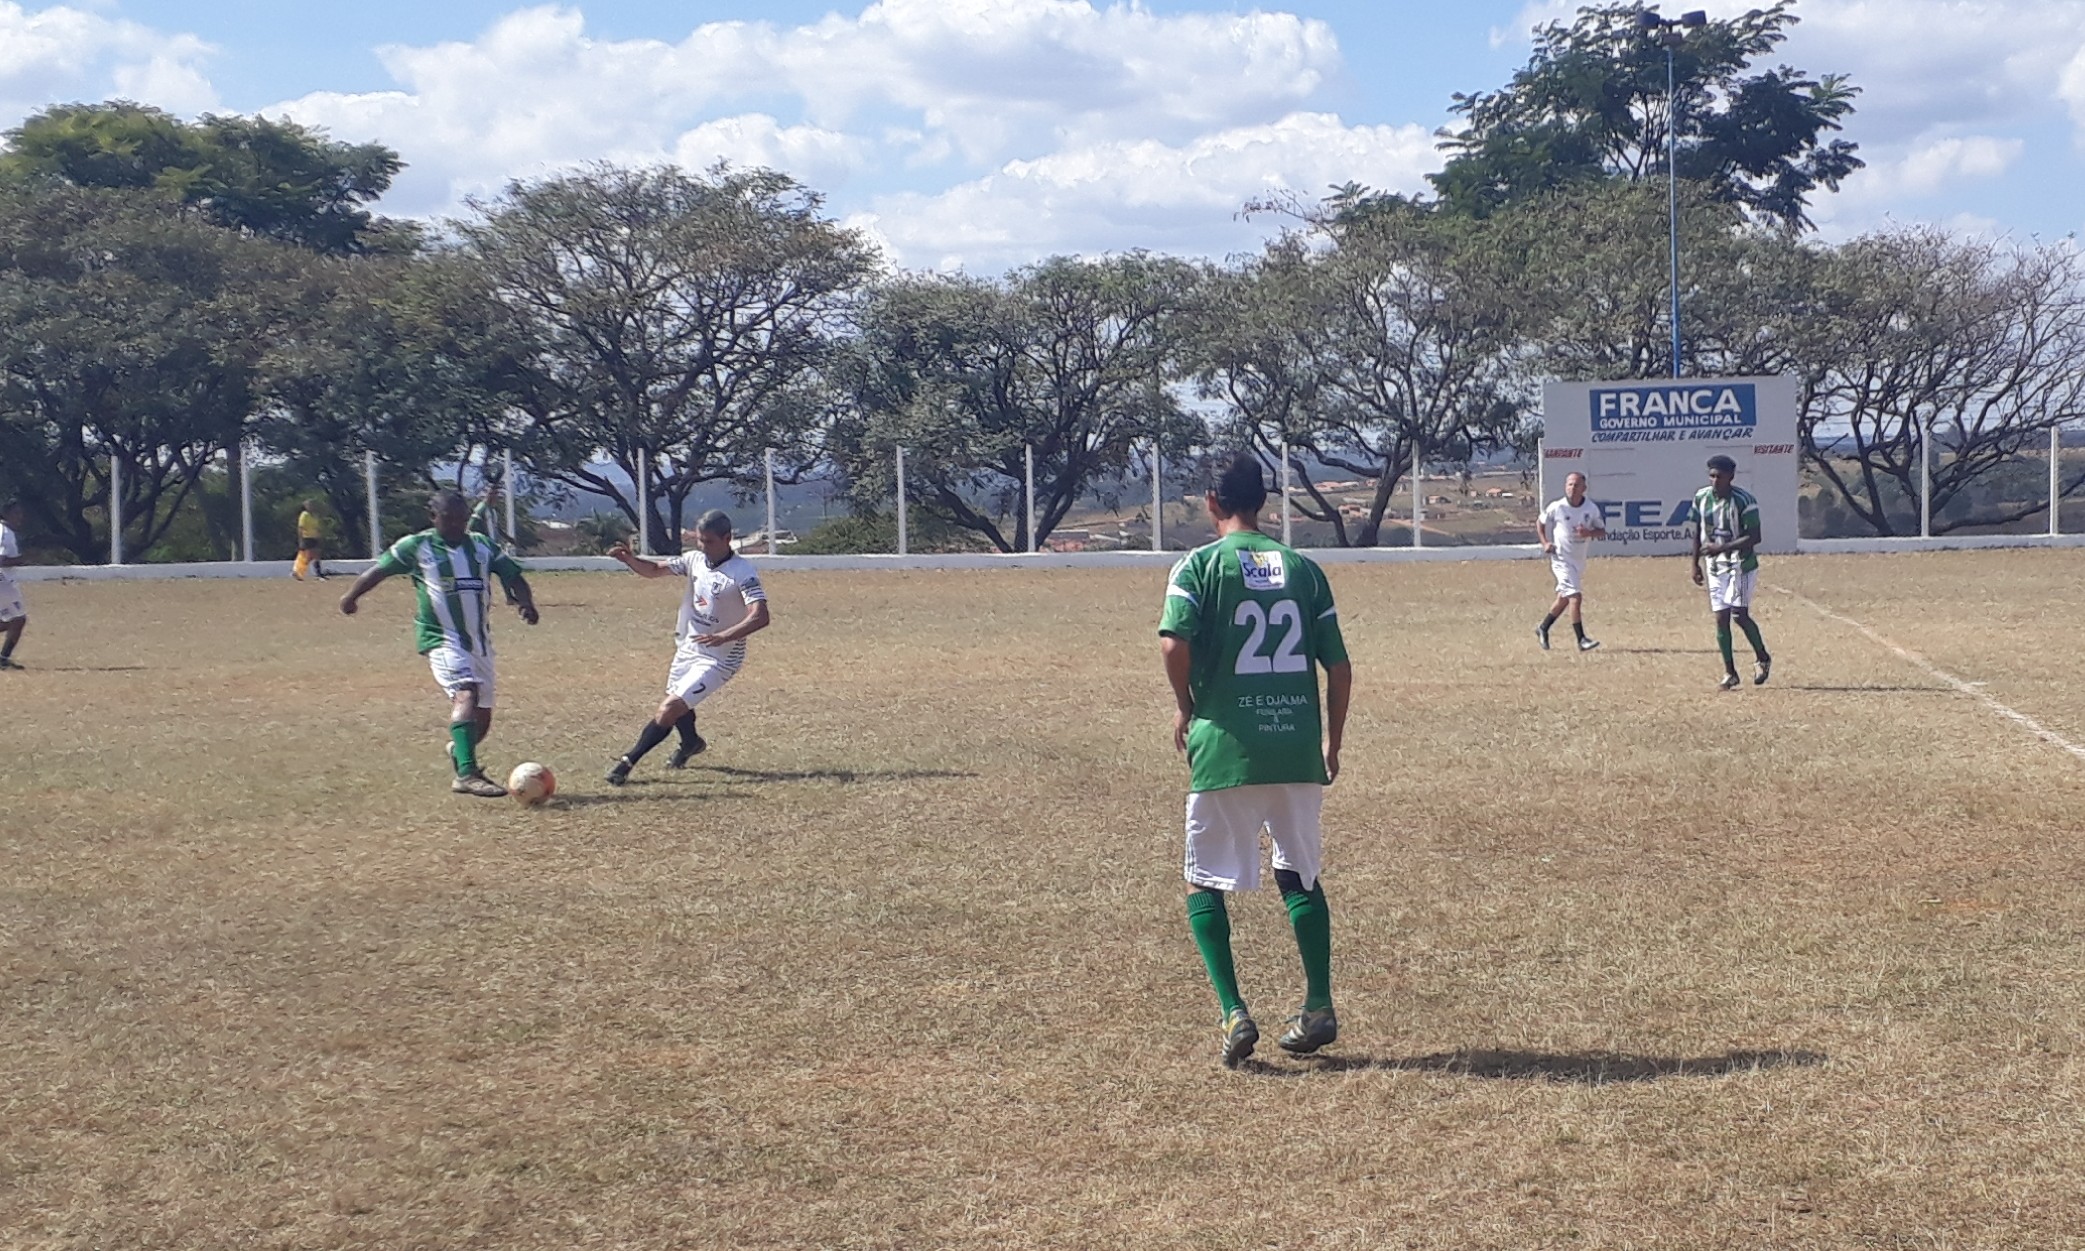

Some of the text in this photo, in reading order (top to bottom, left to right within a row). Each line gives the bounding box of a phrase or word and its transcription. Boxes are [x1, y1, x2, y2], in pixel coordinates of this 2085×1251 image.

[1599, 388, 1742, 417] FRANCA
[1599, 414, 1742, 429] GOVERNO MUNICIPAL
[1591, 427, 1753, 443] COMPARTILHAR E AVANÇAR
[1591, 528, 1640, 545] undação
[1243, 562, 1282, 578] Scala
[1233, 599, 1308, 675] 22
[1256, 695, 1264, 706] E
[1266, 694, 1308, 705] DJALMA
[1258, 723, 1295, 732] PINTURA
